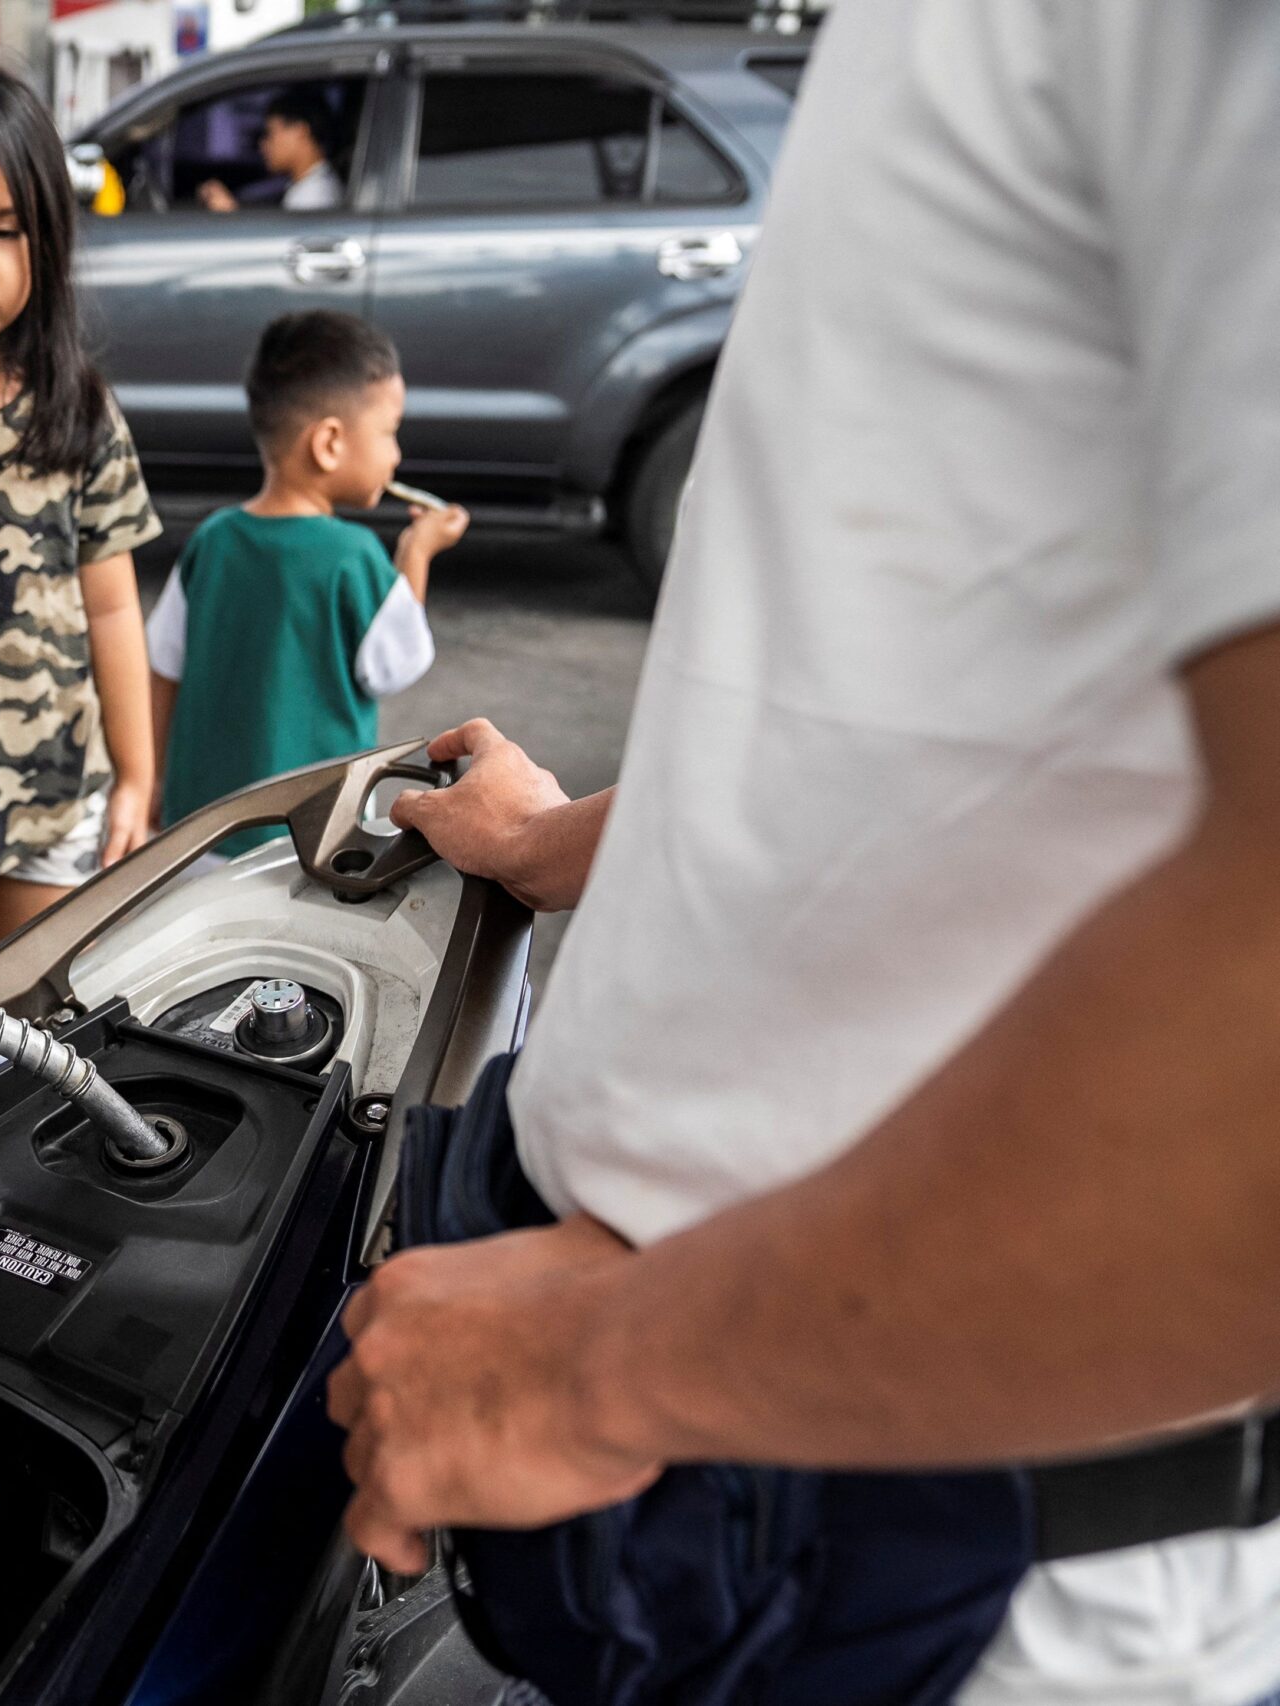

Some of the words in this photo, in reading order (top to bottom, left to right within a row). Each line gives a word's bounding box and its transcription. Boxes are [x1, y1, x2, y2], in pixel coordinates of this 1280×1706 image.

[3, 1232, 26, 1247] COVER
[23, 1240, 37, 1252] THE
[15, 1248, 34, 1261] WITH
[34, 1244, 62, 1261] REMOVE
[32, 1254, 50, 1267] FUEL
[47, 1260, 62, 1272] MIX
[59, 1253, 81, 1268] DON'T
[59, 1265, 82, 1280] DON'T
